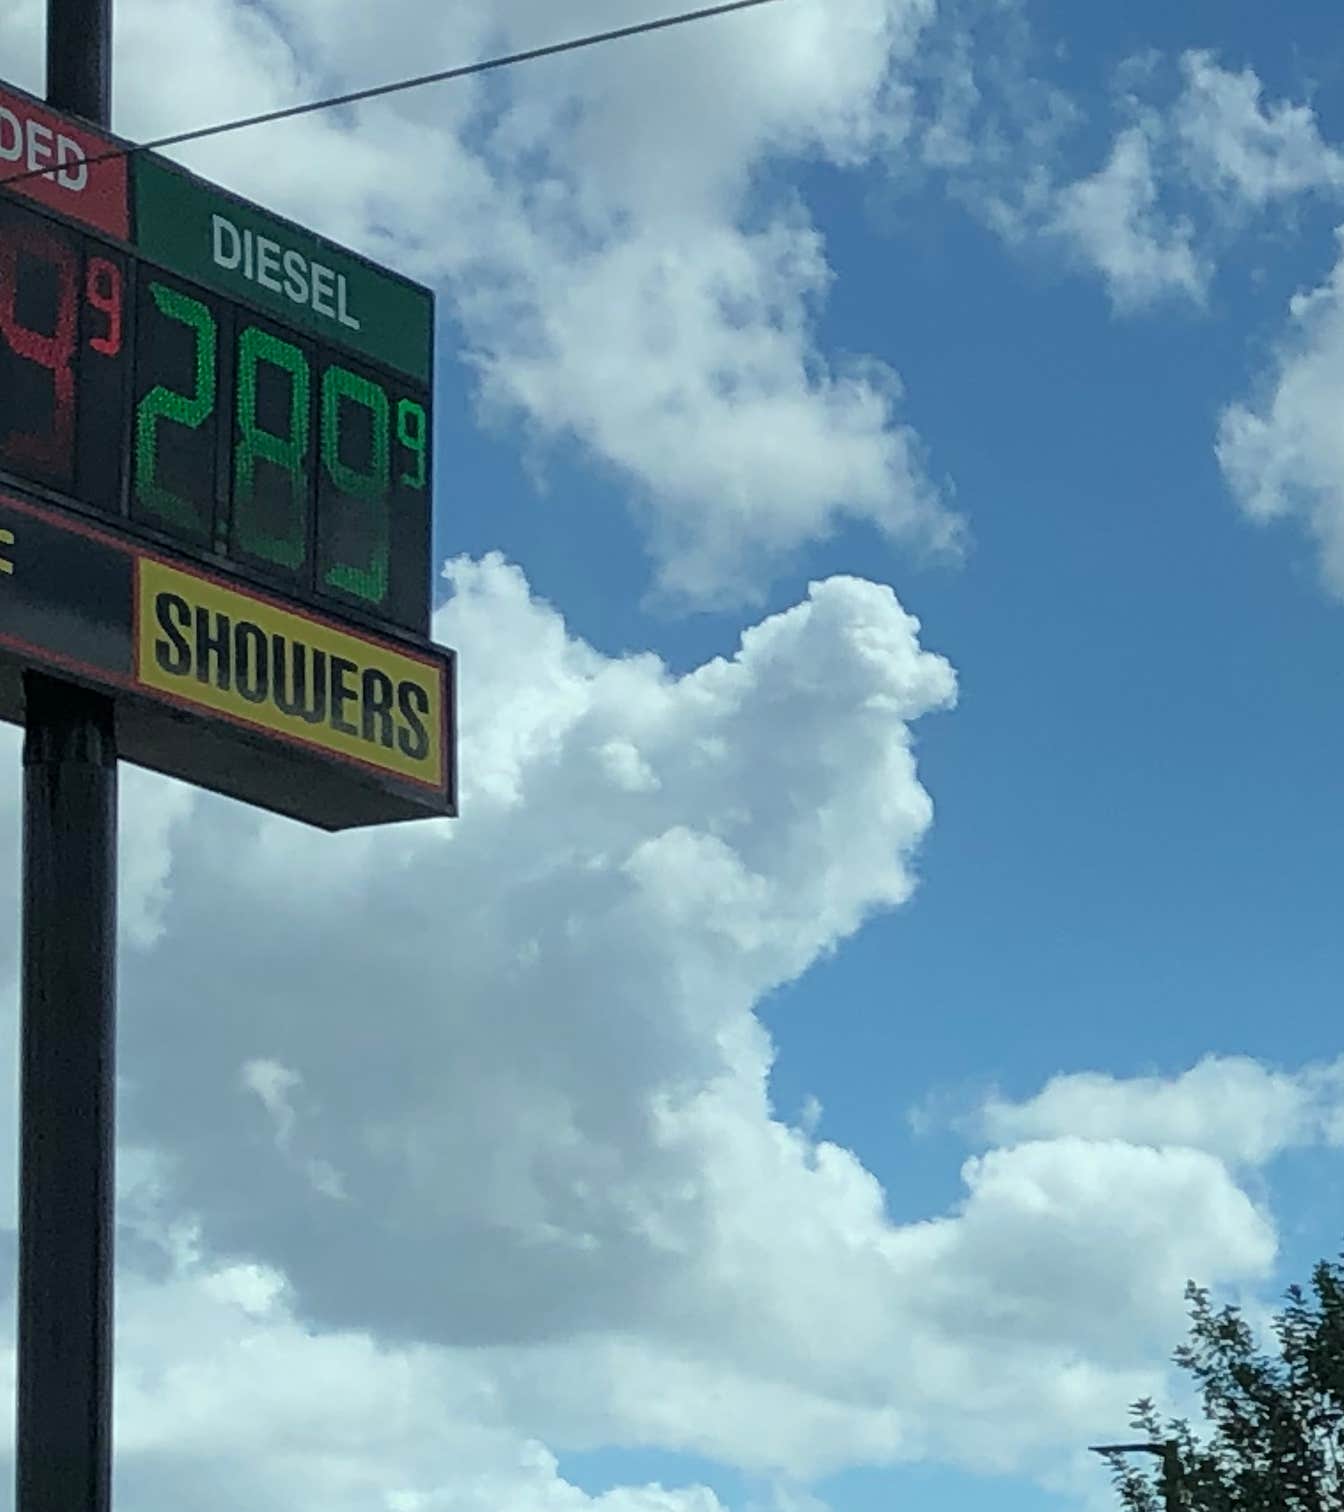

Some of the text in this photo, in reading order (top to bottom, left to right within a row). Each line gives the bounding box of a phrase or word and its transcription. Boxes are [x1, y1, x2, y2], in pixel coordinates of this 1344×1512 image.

[86, 256, 124, 357] 9
[211, 213, 361, 331] DIESEL
[396, 397, 428, 490] 9
[154, 591, 430, 762] SHOWERS
